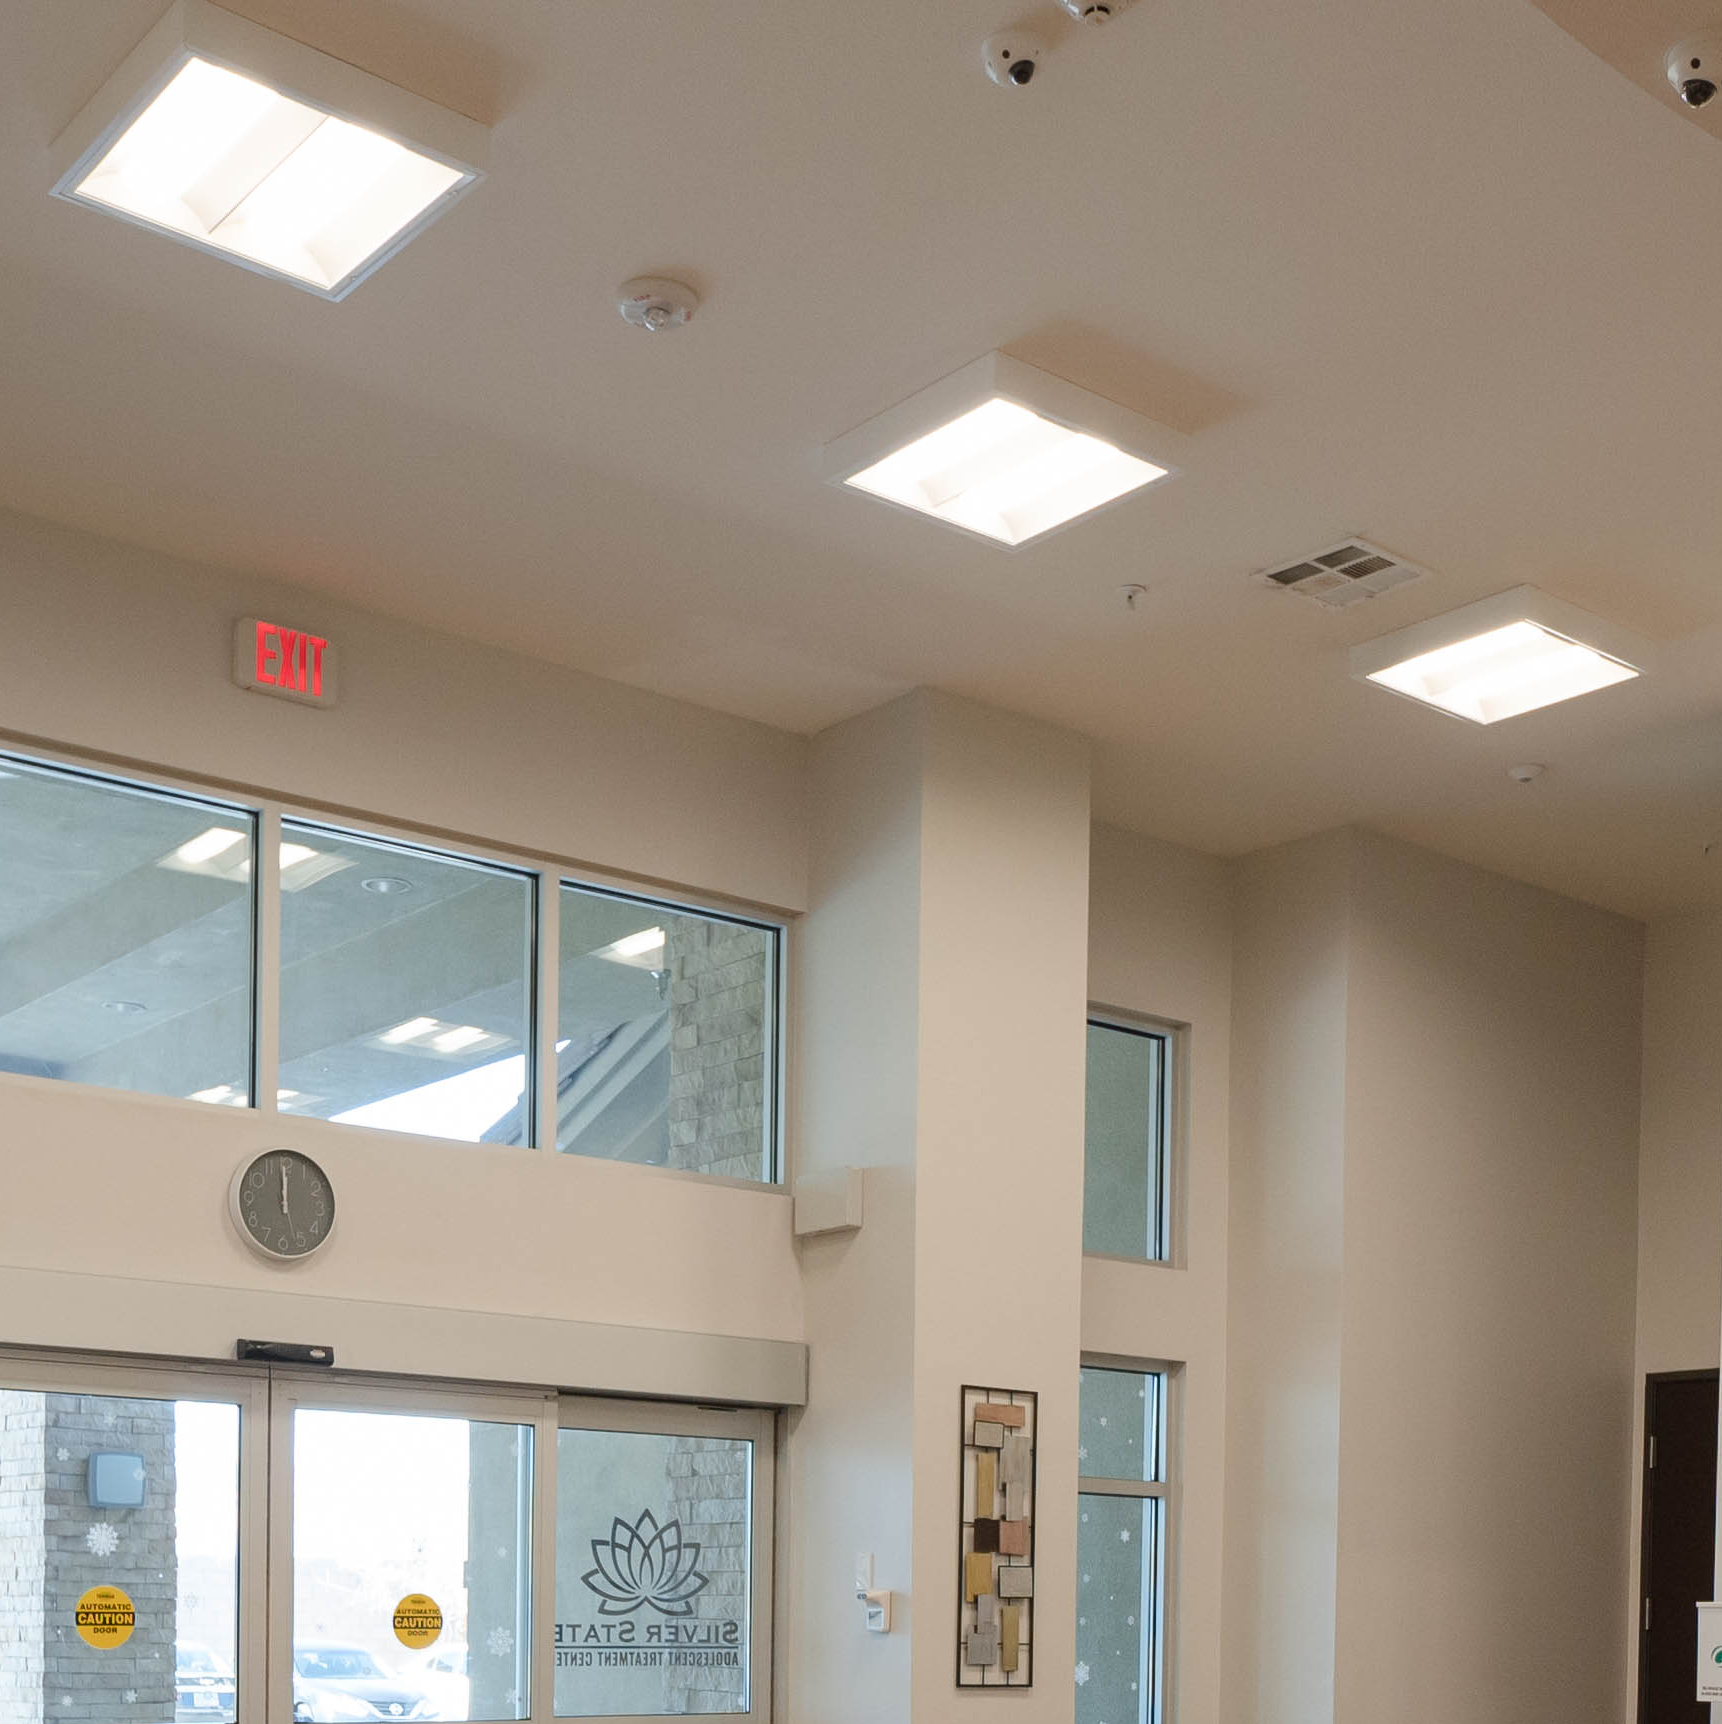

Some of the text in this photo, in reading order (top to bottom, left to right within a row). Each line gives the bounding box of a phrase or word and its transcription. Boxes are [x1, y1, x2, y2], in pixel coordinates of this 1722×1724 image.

[256, 620, 328, 698] EXIT
[249, 1172, 266, 1189] 10
[310, 1180, 323, 1197] 2
[243, 1190, 254, 1207] 9
[315, 1201, 325, 1217] 3
[248, 1211, 258, 1228] 8
[309, 1220, 319, 1235] 4
[261, 1226, 272, 1242] 7
[296, 1232, 308, 1248] 5
[277, 1235, 289, 1250] 6
[79, 1603, 132, 1611] AUTOMATIC
[77, 1613, 133, 1625] CAUTION
[394, 1617, 442, 1628] CAUTION
